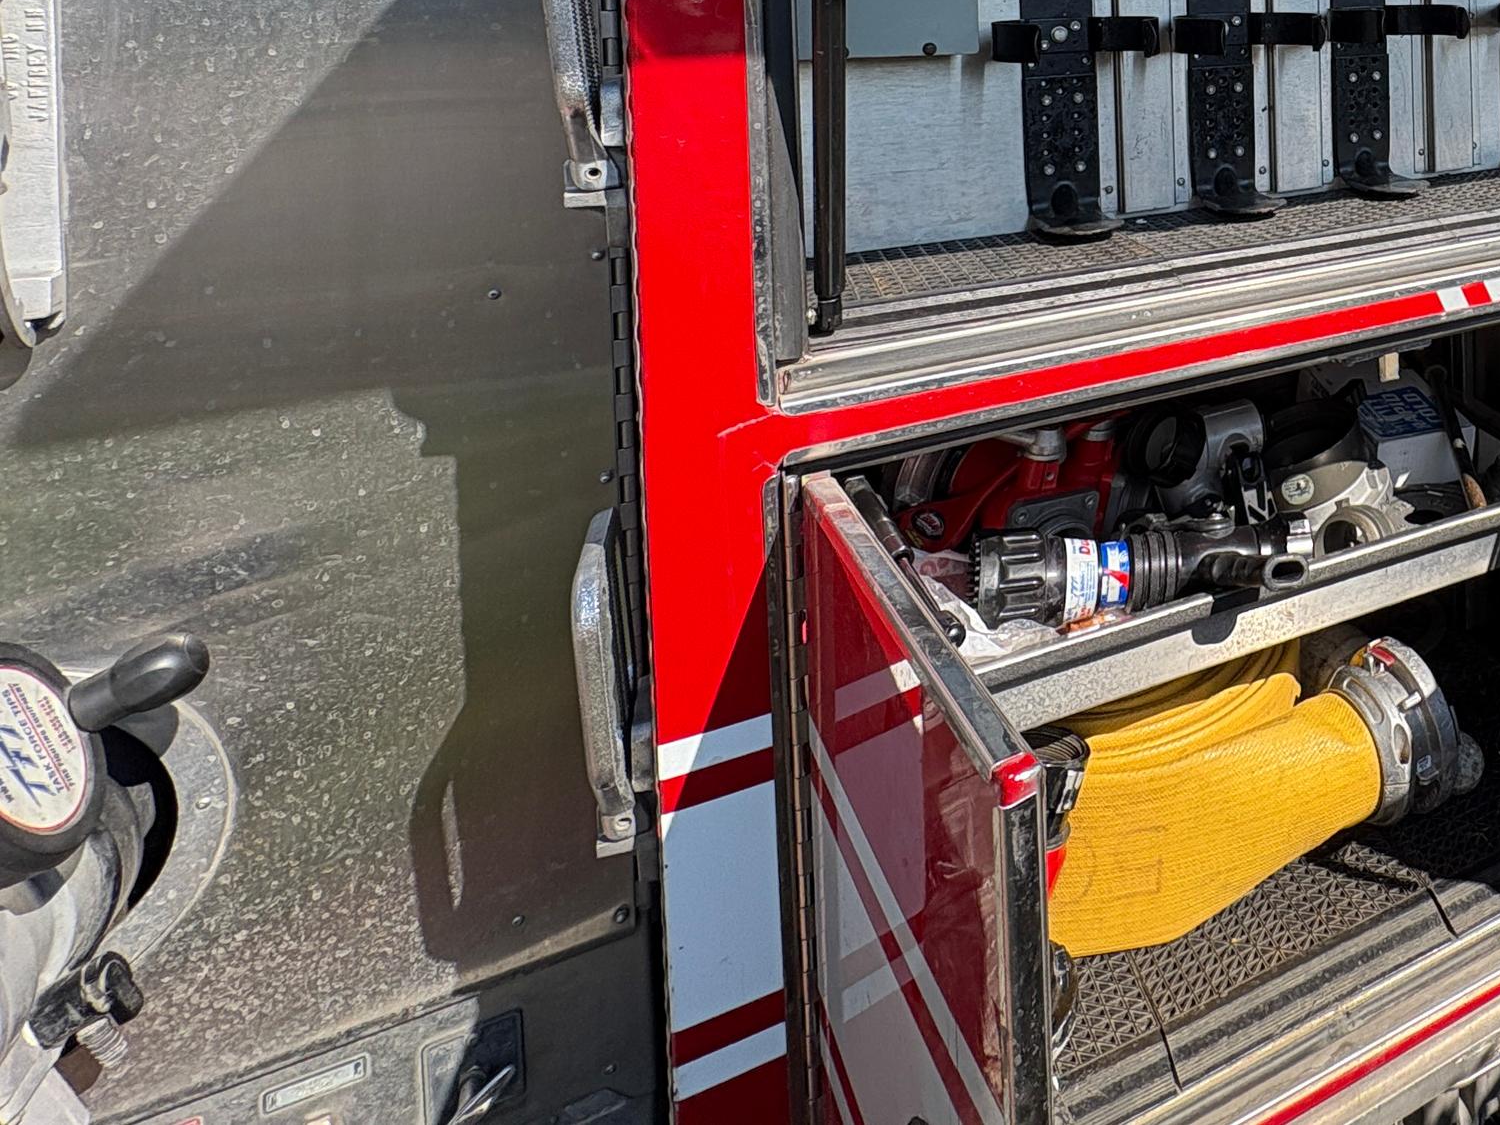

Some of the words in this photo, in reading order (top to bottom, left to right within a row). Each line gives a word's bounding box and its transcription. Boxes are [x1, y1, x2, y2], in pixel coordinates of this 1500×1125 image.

[2, 688, 22, 717] TIPS
[18, 719, 47, 761] FORCE
[42, 763, 65, 794] TASK
